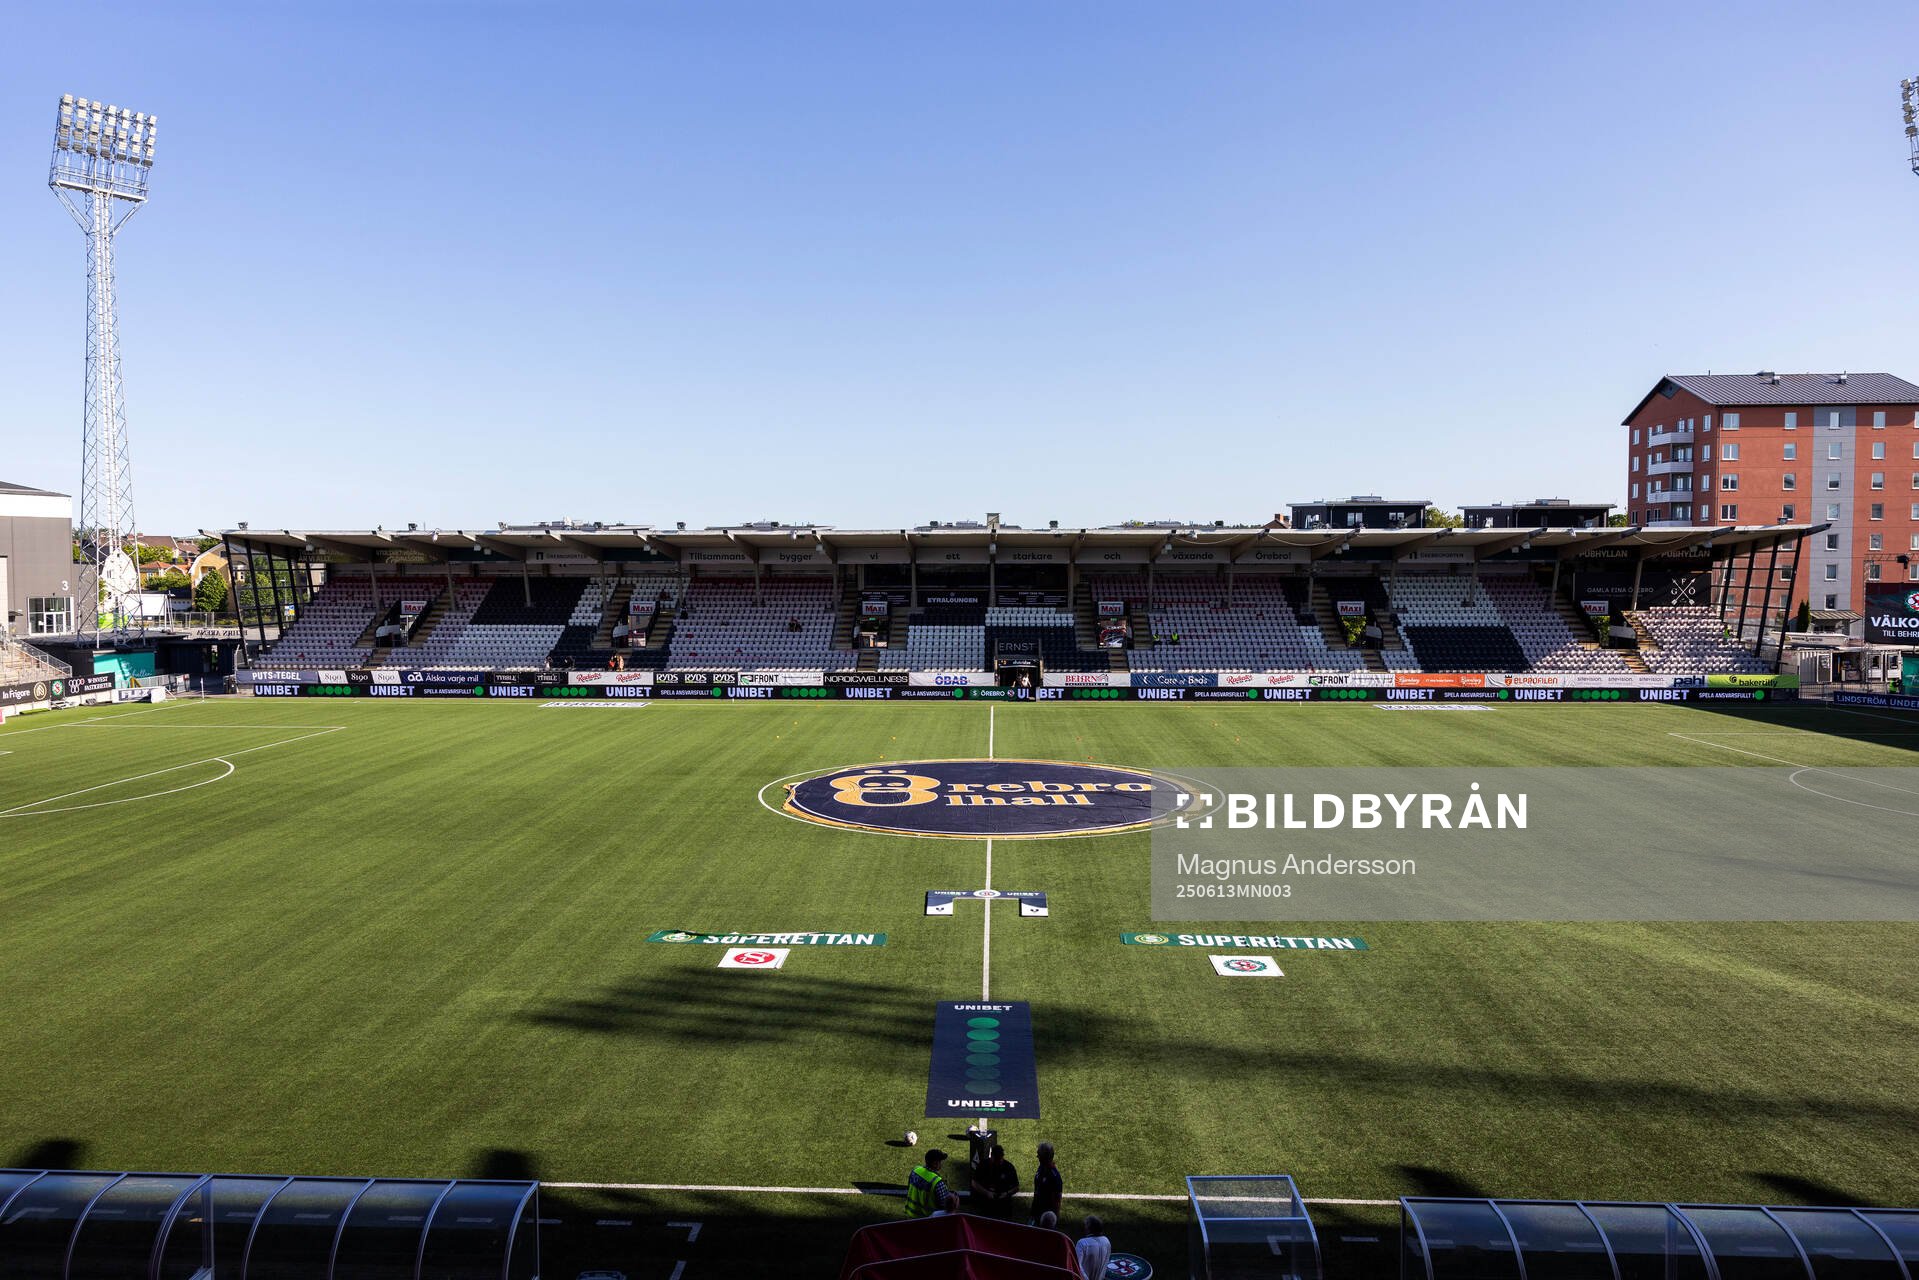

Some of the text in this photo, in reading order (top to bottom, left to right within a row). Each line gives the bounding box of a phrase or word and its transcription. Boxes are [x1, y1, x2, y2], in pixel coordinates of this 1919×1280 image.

[689, 552, 746, 561] Tillsammans
[779, 552, 812, 563] bygger
[870, 552, 878, 560] vi
[946, 552, 960, 560] ett
[1012, 552, 1053, 561] starkare
[1104, 552, 1121, 560] och
[1172, 552, 1214, 560] växande
[1255, 550, 1292, 560] Örebro!
[1579, 550, 1628, 558] PUBHYLLAN
[1661, 550, 1711, 558] PUBHYLLAN
[61, 580, 69, 591] 3
[1681, 578, 1687, 586] F
[1882, 630, 1919, 638] TILL BEHR
[998, 642, 1037, 651] ERNST
[252, 672, 302, 680] PUTS TEGEL
[324, 672, 342, 681] 8190
[350, 672, 368, 682] 8190
[378, 672, 395, 682] 8190
[426, 672, 479, 683] Älska varje mil
[656, 674, 679, 682] RYDS
[684, 674, 707, 682] RYDS
[713, 674, 736, 682] RYDS
[754, 674, 779, 683] FRONT
[1065, 675, 1098, 683] BEHRN
[1324, 676, 1350, 684] FRONT
[1674, 676, 1706, 687] pahl
[1739, 679, 1778, 688] bakertilly
[2, 691, 10, 699] In
[255, 685, 300, 696] UNIBET
[370, 686, 415, 696] UNIBET
[490, 686, 535, 696] UNIBET
[606, 686, 652, 697] UNIBET
[728, 687, 774, 698] UNIBET
[846, 688, 892, 698] UNIBET
[1138, 688, 1186, 698] UNIBET
[1264, 689, 1312, 699] UNIBET
[1386, 690, 1435, 700] UNIBET
[1514, 690, 1564, 700] UNIBET
[1640, 690, 1690, 700] UNIBET
[1836, 694, 1919, 708] LINDSTRÖM UNDE
[1177, 934, 1356, 949] SUPERETTAN
[948, 1100, 1018, 1108] UNIBET
